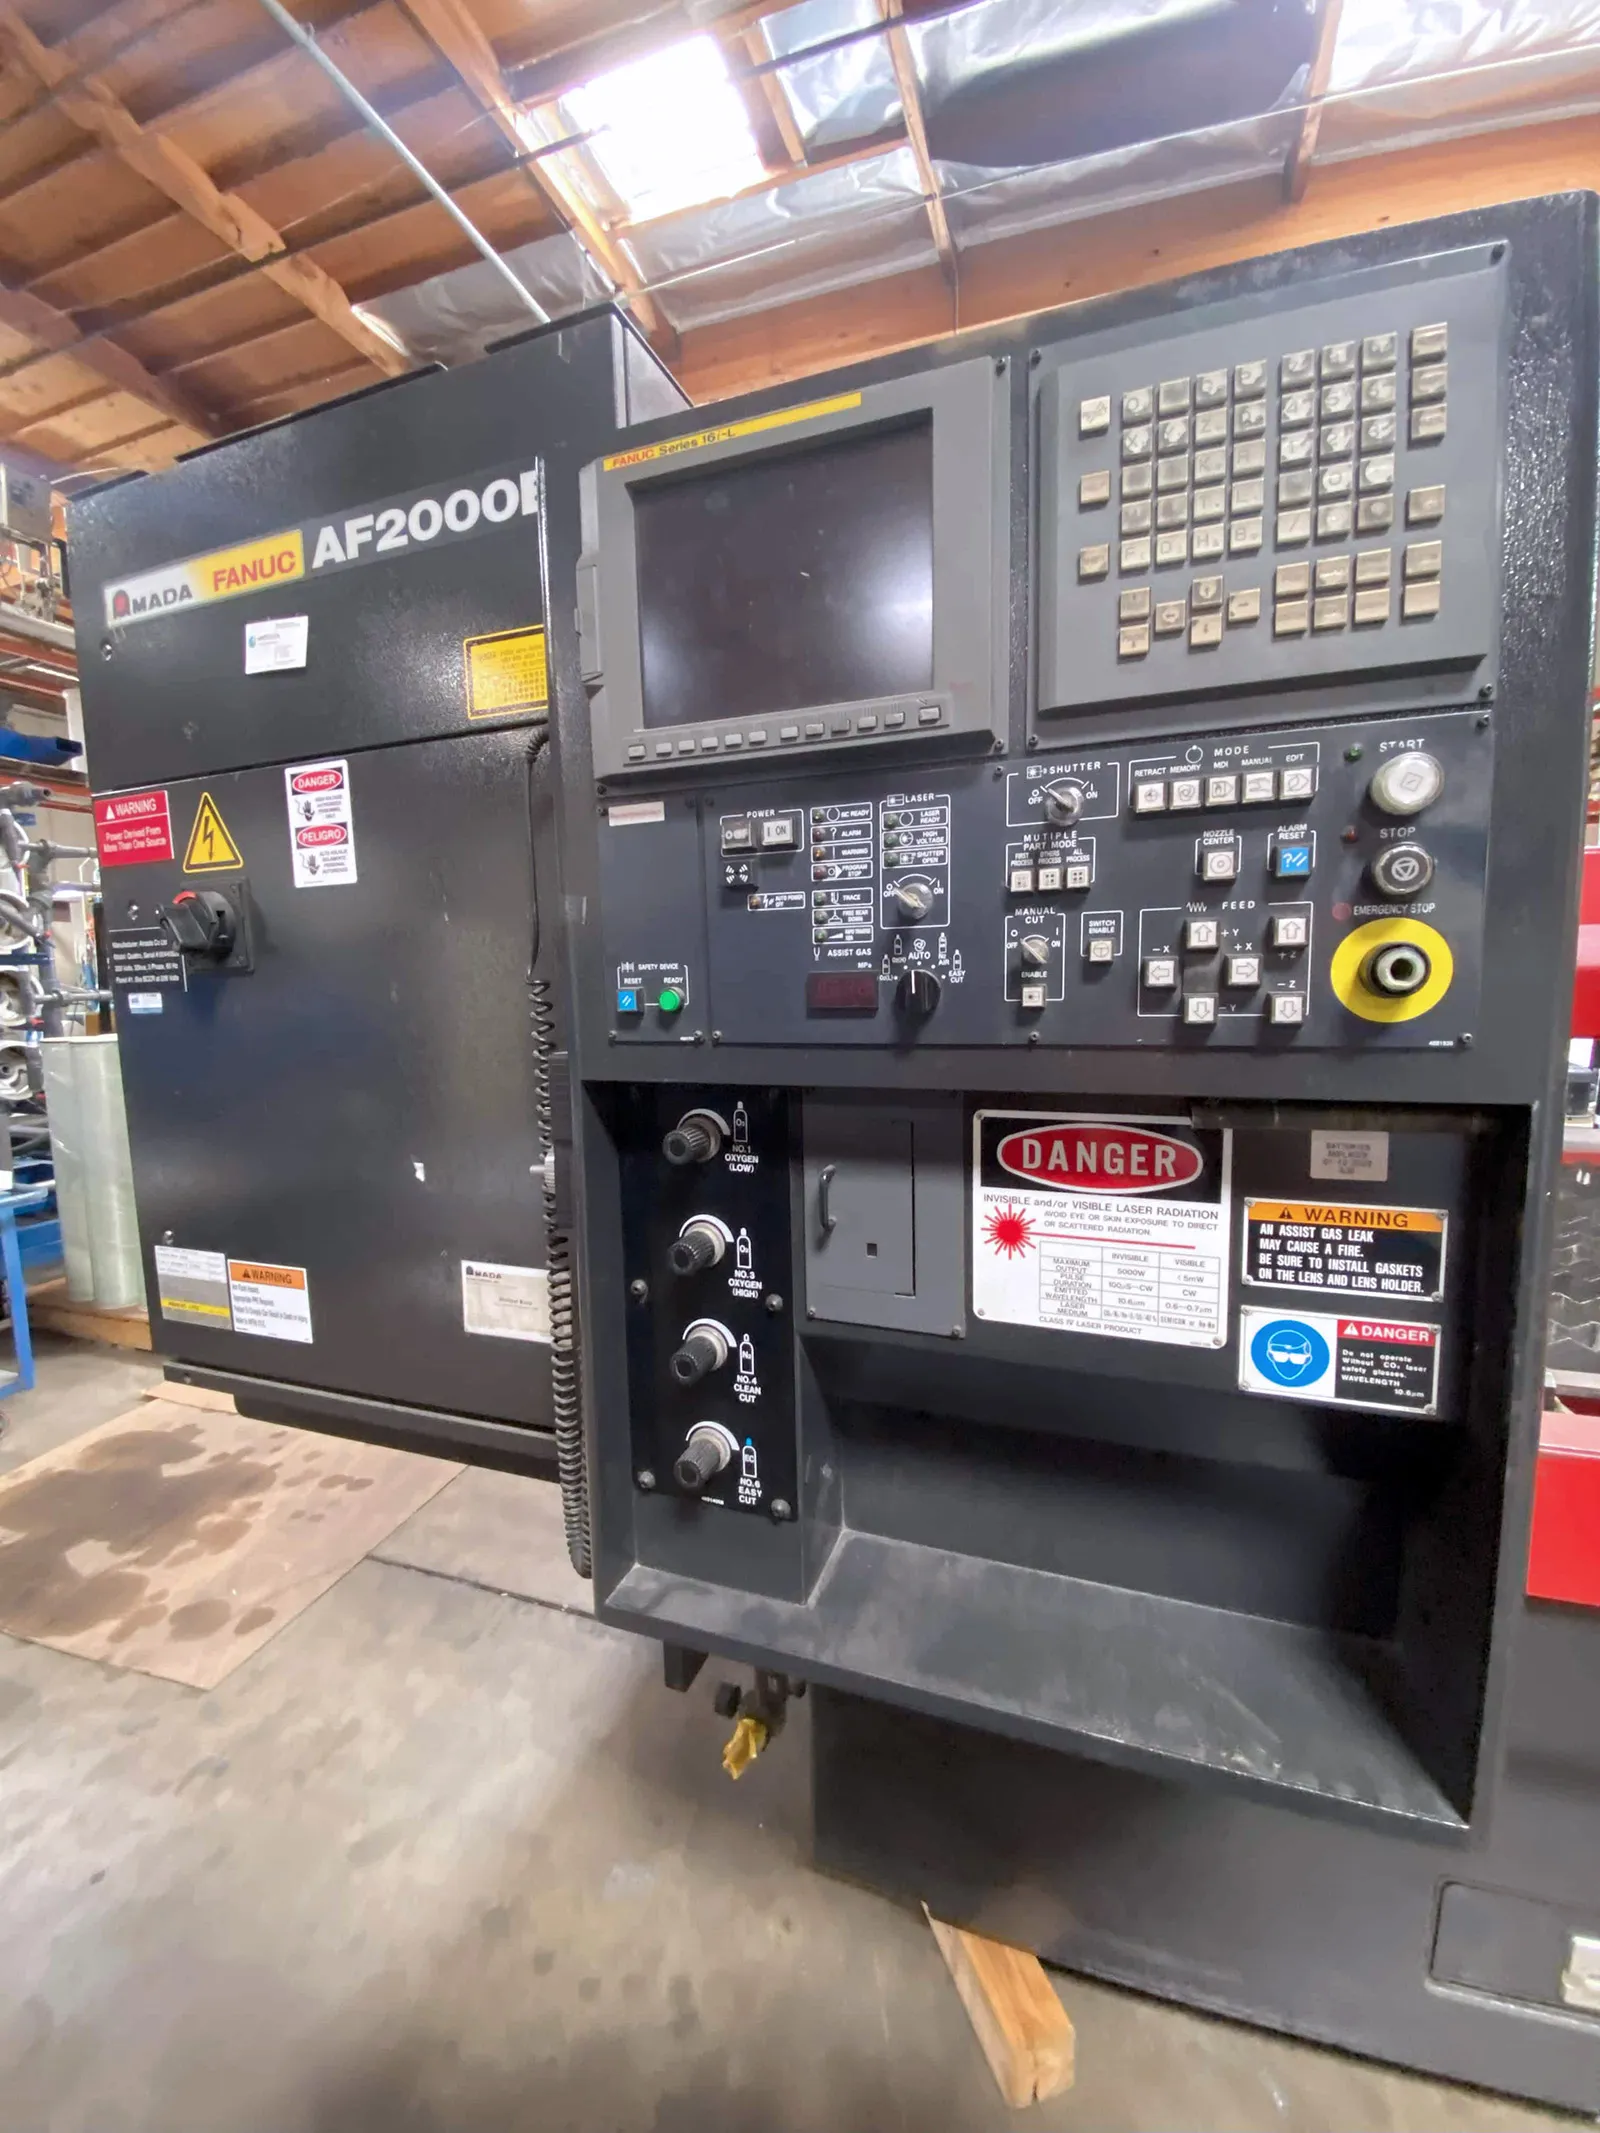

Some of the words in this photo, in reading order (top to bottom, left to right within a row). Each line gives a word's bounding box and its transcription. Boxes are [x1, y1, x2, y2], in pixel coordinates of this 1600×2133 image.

[612, 450, 655, 467] FANUC
[659, 440, 698, 456] Series
[213, 551, 296, 592] FANUC
[1380, 739, 1425, 752] START
[1214, 746, 1249, 756] MODE
[1050, 762, 1101, 774] SHUTTER
[1135, 767, 1166, 776] RETRACT
[1170, 764, 1201, 773] MEMORY
[1214, 761, 1228, 769] MDI
[1241, 758, 1272, 766] MANUAL
[1286, 754, 1303, 762] EDIT
[298, 775, 336, 788] DANGER
[905, 794, 934, 803] LASER
[1028, 797, 1043, 805] OFF
[115, 798, 156, 816] WARNING
[747, 810, 775, 818] POWER
[776, 826, 786, 835] ON
[1203, 829, 1234, 837] NOZZLE
[1278, 824, 1307, 832] ALARM
[1380, 827, 1416, 838] STOP
[302, 830, 341, 842] PELIGRO
[1203, 837, 1234, 845] CENTER
[1279, 832, 1305, 840] RESET
[1024, 841, 1046, 850] PART
[1051, 840, 1076, 848] MODE
[917, 850, 944, 858] SHUTTER
[1222, 901, 1255, 910] FEED
[1353, 904, 1408, 915] EMERGENCY
[1411, 903, 1435, 914] STOP
[1015, 907, 1055, 916] MANUAL
[1025, 916, 1045, 924] CUT
[908, 952, 931, 960] AUTO
[725, 1154, 759, 1163] OXYGEN
[1023, 1138, 1177, 1178] DANGER
[729, 1164, 754, 1173] (LOW)
[984, 1193, 1031, 1206] INVISIBLE
[1034, 1199, 1067, 1209] and/or
[1072, 1201, 1111, 1212] VISIBLE
[1117, 1204, 1152, 1215] LASER
[1156, 1208, 1218, 1220] RADIATION
[1044, 1210, 1067, 1218] AVOID
[1070, 1211, 1085, 1219] EYE
[1125, 1217, 1169, 1227] EXPOSURE
[1173, 1220, 1184, 1228] TO
[1187, 1222, 1218, 1231] DIRECT
[1304, 1208, 1408, 1228] WARNING
[1059, 1222, 1104, 1232] SCATTERED
[1260, 1224, 1273, 1235] AN
[1279, 1225, 1316, 1239] ASSIST
[1322, 1228, 1343, 1240] GAS
[1348, 1229, 1374, 1243] LEAK
[1259, 1239, 1280, 1251] MAY
[1287, 1241, 1319, 1254] CAUSE
[1325, 1244, 1332, 1255] A
[1338, 1245, 1364, 1257] FIRE.
[1112, 1252, 1148, 1262] INVISIBLE
[1053, 1258, 1090, 1267] MAXIMUM
[1175, 1259, 1205, 1268] VISIBLE
[1259, 1254, 1272, 1265] BE
[1277, 1255, 1303, 1268] SURE
[1309, 1257, 1322, 1269] TO
[1328, 1258, 1369, 1273] INSTALL
[1375, 1262, 1423, 1277] GASKETS
[1056, 1265, 1087, 1274] OUTPUT
[1117, 1269, 1146, 1277] 5000W
[251, 1269, 292, 1284] WARNING
[1060, 1273, 1084, 1281] PULSE
[1183, 1275, 1204, 1283] 5mW
[1259, 1268, 1272, 1279] ON
[1277, 1269, 1295, 1281] THE
[1299, 1271, 1323, 1284] LENS
[1327, 1274, 1348, 1286] AND
[1352, 1276, 1377, 1290] LENS
[1381, 1279, 1424, 1293] HOLDER.
[728, 1278, 762, 1290] OXYGEN
[1053, 1280, 1092, 1289] DURATION
[732, 1288, 759, 1298] (HIGH)
[1054, 1287, 1088, 1296] EMITTED
[1045, 1292, 1097, 1304] WAVELENGTH
[1057, 1308, 1088, 1317] MEDIUM
[1039, 1316, 1064, 1325] CLASS
[1076, 1320, 1101, 1329] LASER
[1104, 1324, 1142, 1334] PRODUCT
[1362, 1324, 1430, 1342] DANGER
[1342, 1349, 1354, 1357] Do
[1380, 1353, 1412, 1363] operate
[1342, 1357, 1374, 1367] Without
[1406, 1363, 1427, 1372] laser
[1341, 1365, 1366, 1375] safety
[1373, 1368, 1407, 1378] glasses.
[1341, 1374, 1400, 1387] WAVELENGTH
[734, 1384, 761, 1395] CLEAN
[739, 1394, 756, 1403] CUT
[739, 1486, 762, 1497] EASY
[739, 1496, 757, 1505] CUT
